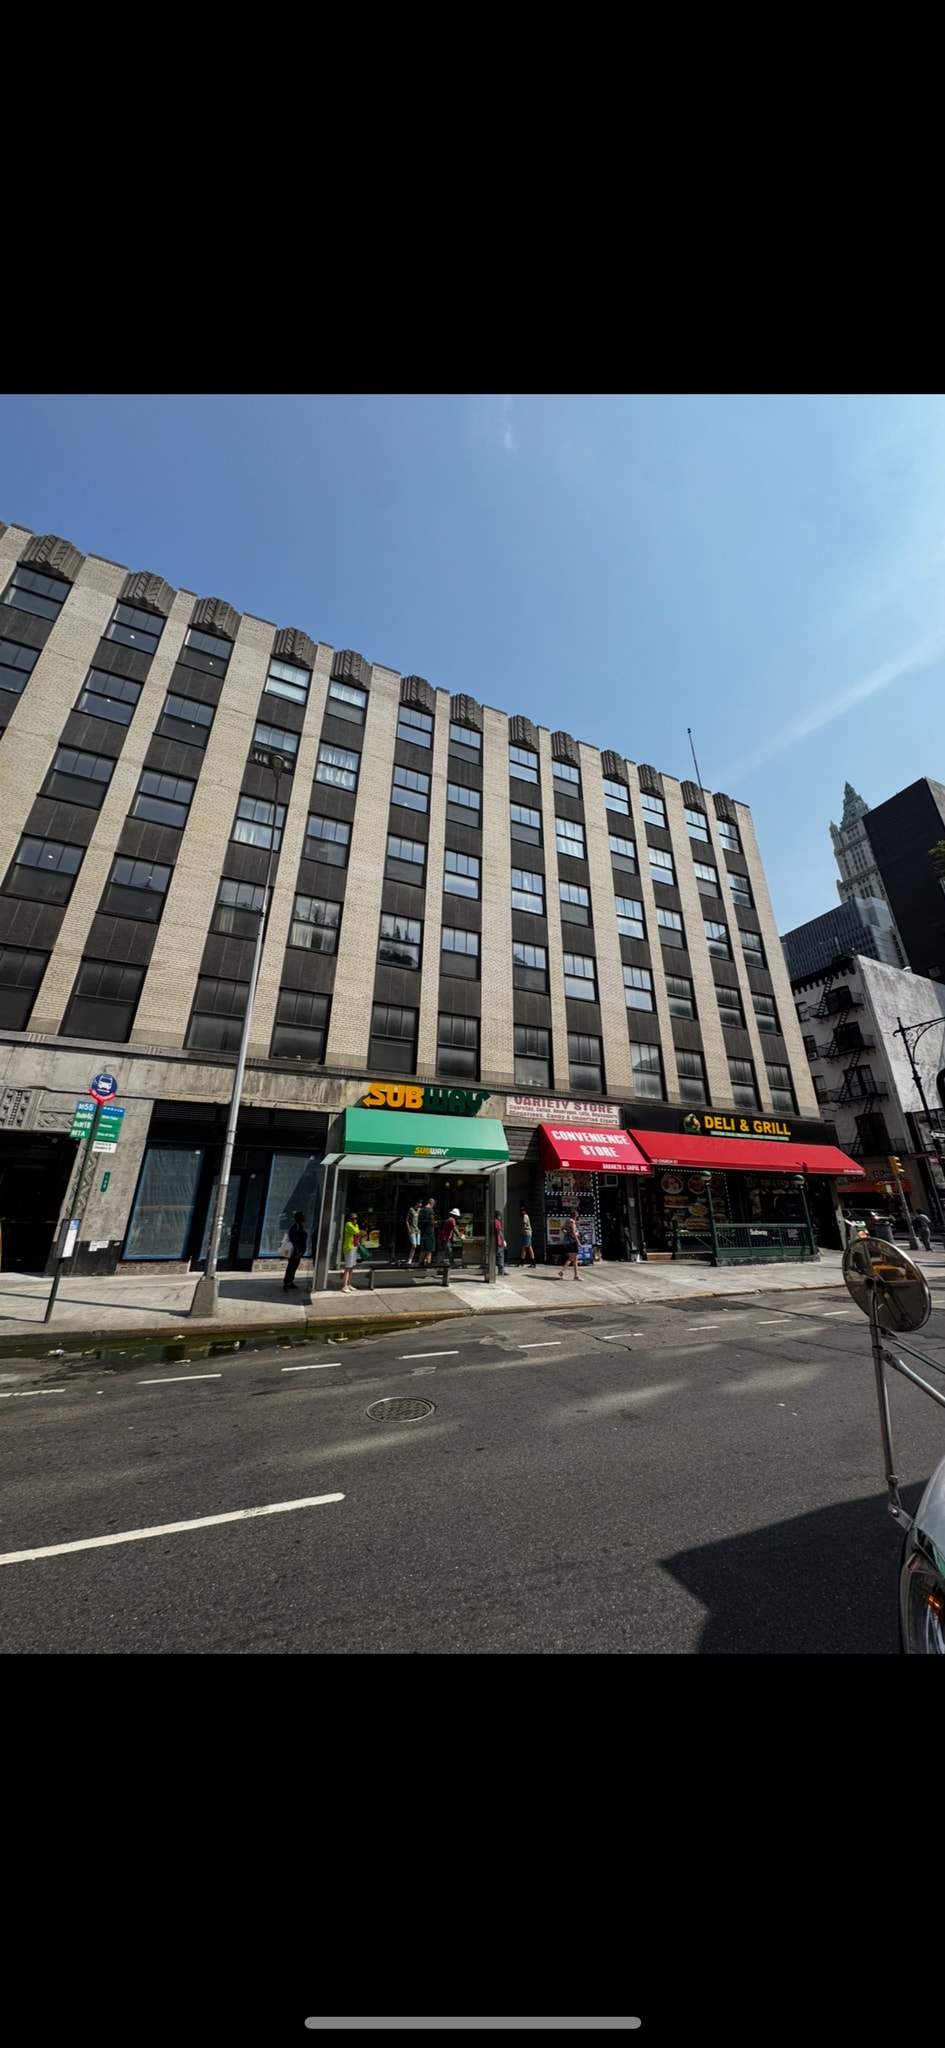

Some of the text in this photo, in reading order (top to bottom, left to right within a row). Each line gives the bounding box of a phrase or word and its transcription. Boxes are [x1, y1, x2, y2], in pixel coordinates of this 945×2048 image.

[363, 1082, 490, 1115] SUBWAY
[513, 1096, 614, 1114] VARIETY STORE
[78, 1103, 94, 1111] M55
[704, 1115, 735, 1131] DELI
[740, 1119, 750, 1132] &
[753, 1120, 791, 1136] GRILL
[70, 1129, 86, 1137] MTA
[551, 1130, 630, 1145] CONVENIENCE
[414, 1146, 449, 1156] SUBWAY
[580, 1145, 620, 1158] STORE
